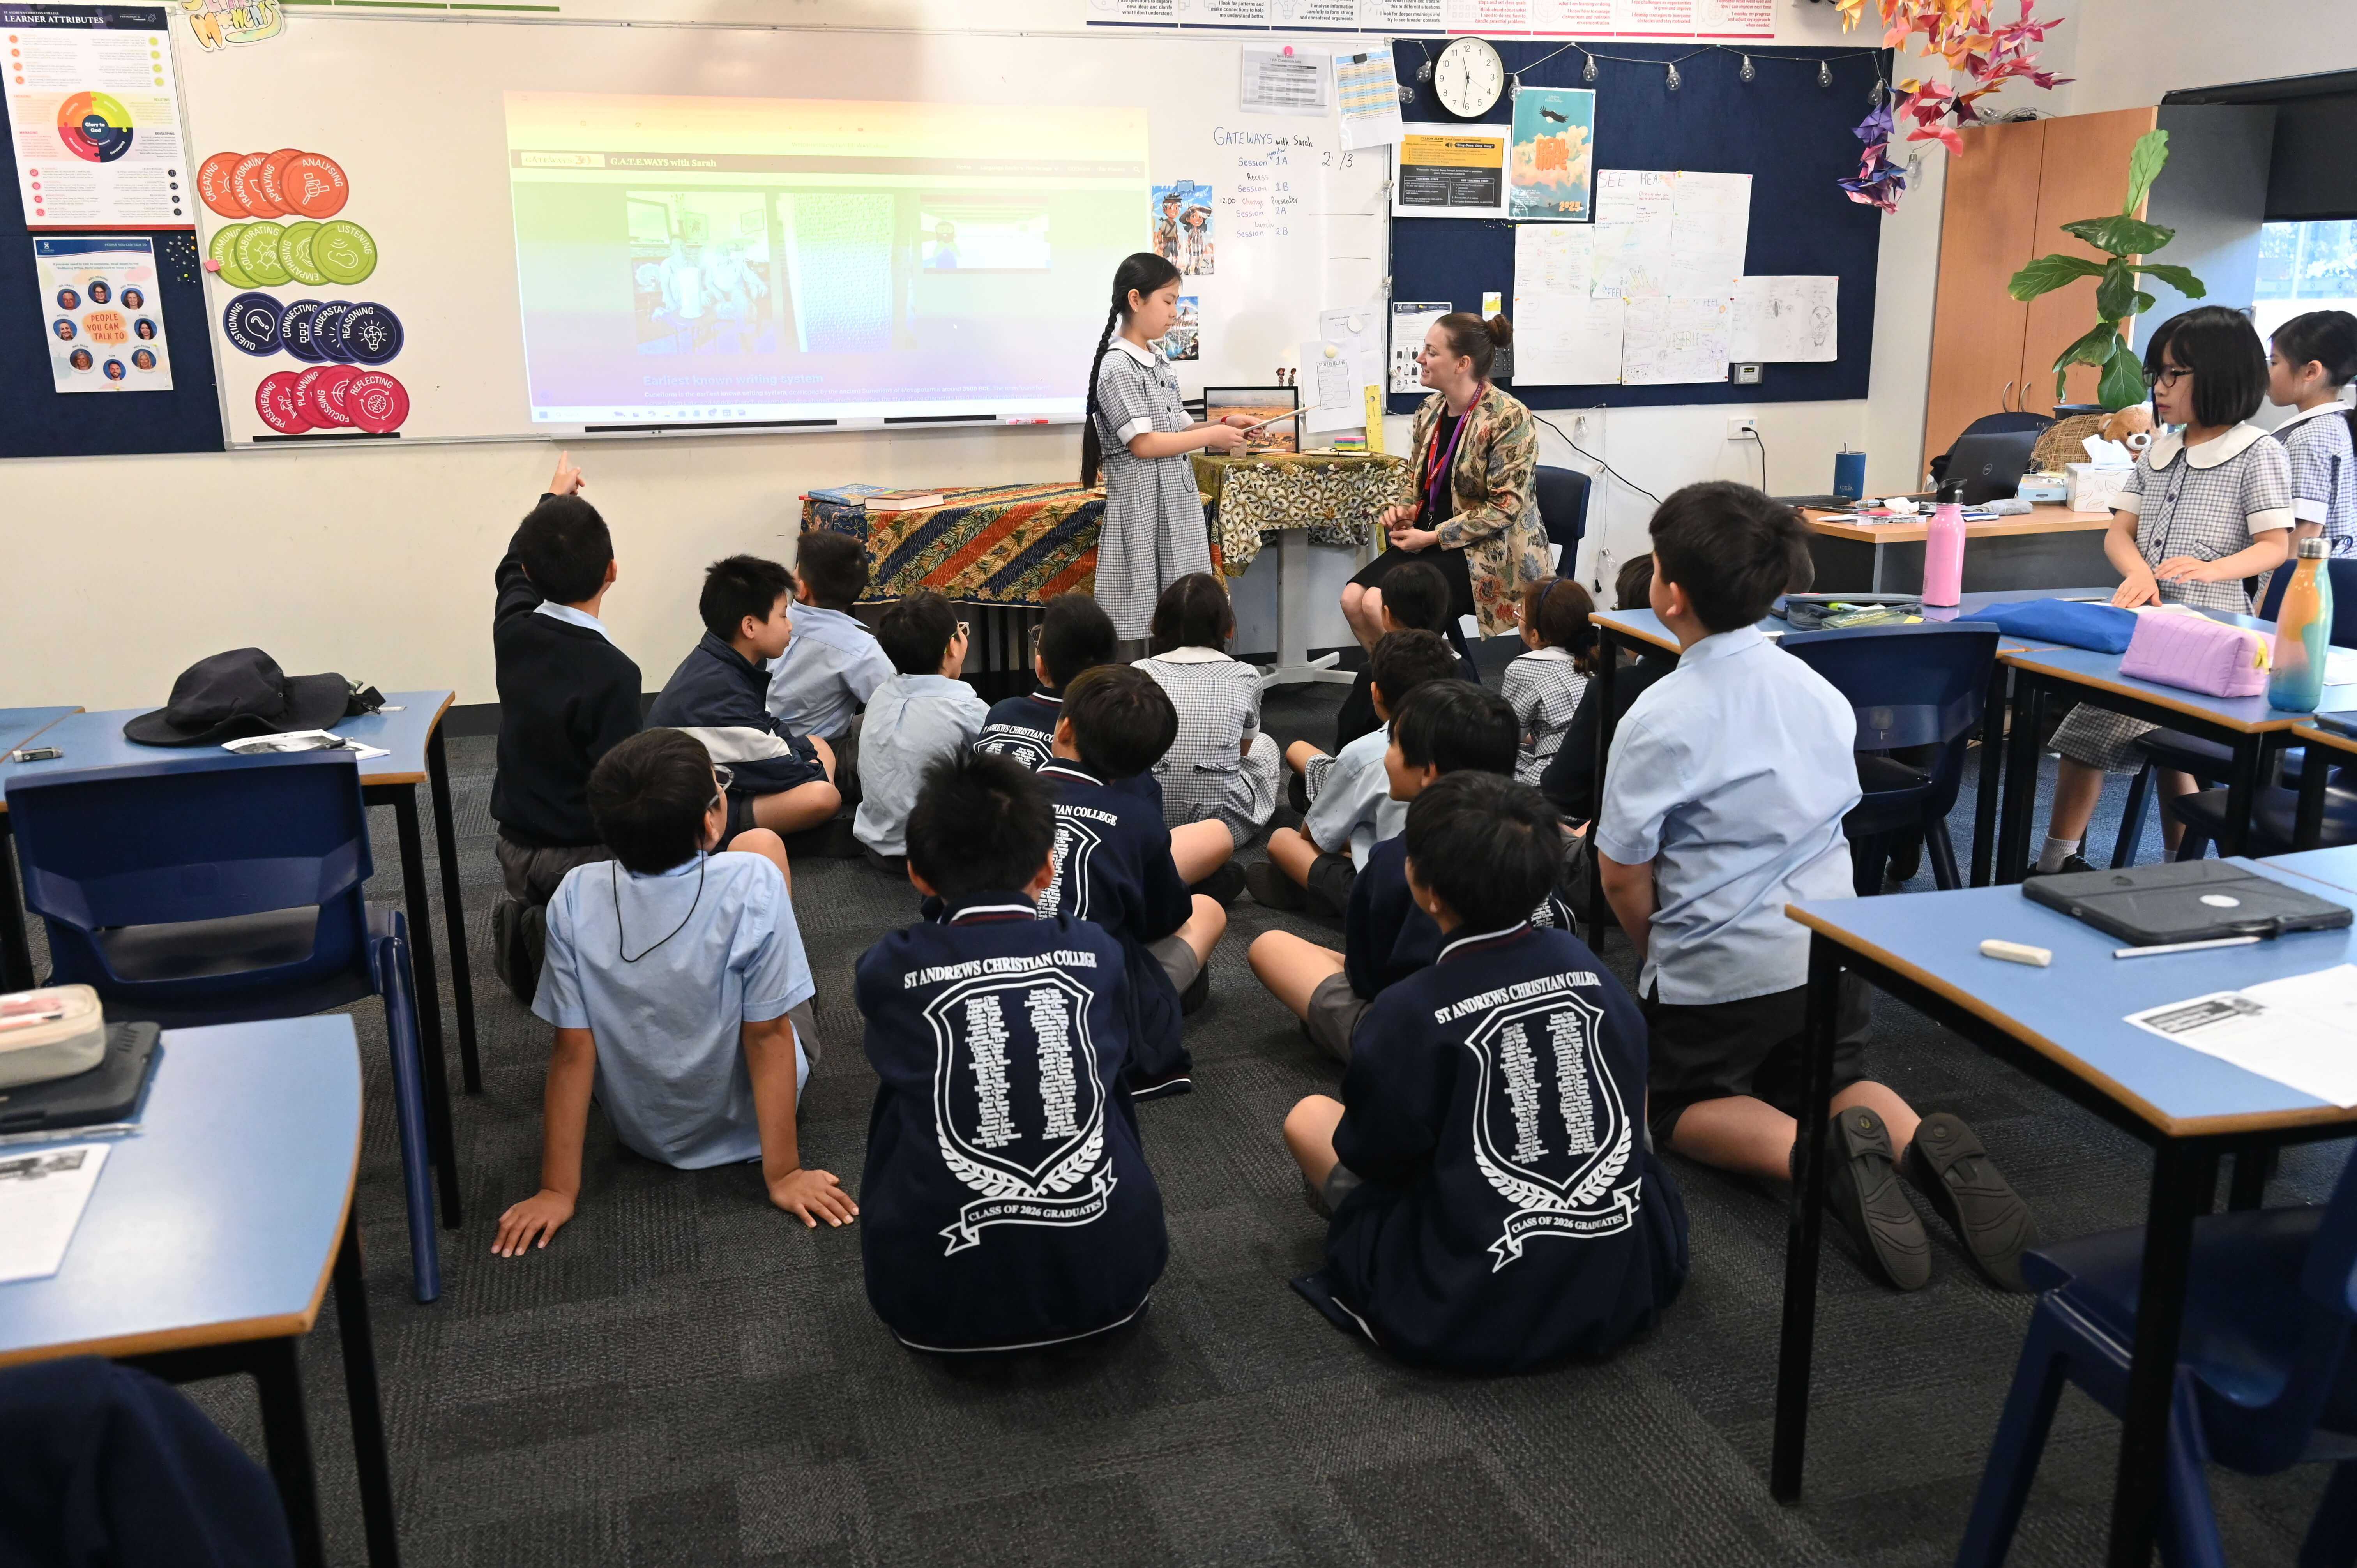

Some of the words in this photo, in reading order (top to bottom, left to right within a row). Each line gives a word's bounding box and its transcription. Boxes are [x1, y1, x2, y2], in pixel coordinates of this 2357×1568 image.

[1276, 137, 1289, 146] with
[1293, 135, 1313, 147] Sarah
[1536, 138, 1569, 156] REAL
[1238, 157, 1267, 166] Session
[1276, 156, 1288, 165] 1A
[1535, 154, 1569, 171] HOPE
[203, 162, 219, 201] CREATING
[302, 158, 343, 187] ANALYSING
[1247, 173, 1269, 181] Recess
[1599, 172, 1626, 188] SEE
[265, 164, 282, 203] APPLYING
[1276, 182, 1289, 191] 1B
[1242, 198, 1264, 209] Change
[1271, 195, 1298, 205] Presenter
[1255, 220, 1275, 228] Lunch
[1276, 227, 1288, 235] 2B
[240, 226, 279, 270] COLLABORATING
[337, 225, 372, 254] LISTENING
[283, 240, 320, 281] EMPATHISING
[1607, 288, 1622, 298] FEEL
[91, 314, 118, 322] PEOPLE
[228, 302, 256, 350] QUESTIONING
[282, 304, 318, 338] CONNECTING
[342, 307, 374, 339] REASONING
[1665, 331, 1699, 347] VISIBLE
[297, 371, 318, 406] PLANNING
[350, 376, 394, 395] REFLECTING
[643, 375, 689, 386] Earliest
[692, 374, 733, 385] known
[736, 374, 777, 386] writing
[780, 374, 823, 386] system
[261, 381, 286, 428] PERSEVERING
[317, 389, 349, 422] FOCUSSING
[986, 724, 1011, 733] ANDREWS
[1009, 725, 1044, 739] CHRISTIAN
[1073, 806, 1118, 826] COLLEGE
[904, 972, 919, 989] ST
[920, 961, 981, 985] ANDREWS
[982, 952, 1053, 974] CHRISTIAN
[1053, 950, 1097, 968] COLLEGE
[1435, 1008, 1451, 1024] ST
[1452, 988, 1509, 1019] ANDREWS
[1509, 974, 1566, 999] CHRISTIAN
[968, 1206, 1001, 1222] CLASS
[1004, 1205, 1017, 1214] OF
[1021, 1205, 1042, 1216] 2026
[1043, 1199, 1102, 1218] GRADUATES
[1511, 1218, 1537, 1233] CLASS
[1538, 1216, 1552, 1225] OF
[1553, 1218, 1574, 1229] 2026
[1575, 1214, 1624, 1230] GRADUATES
